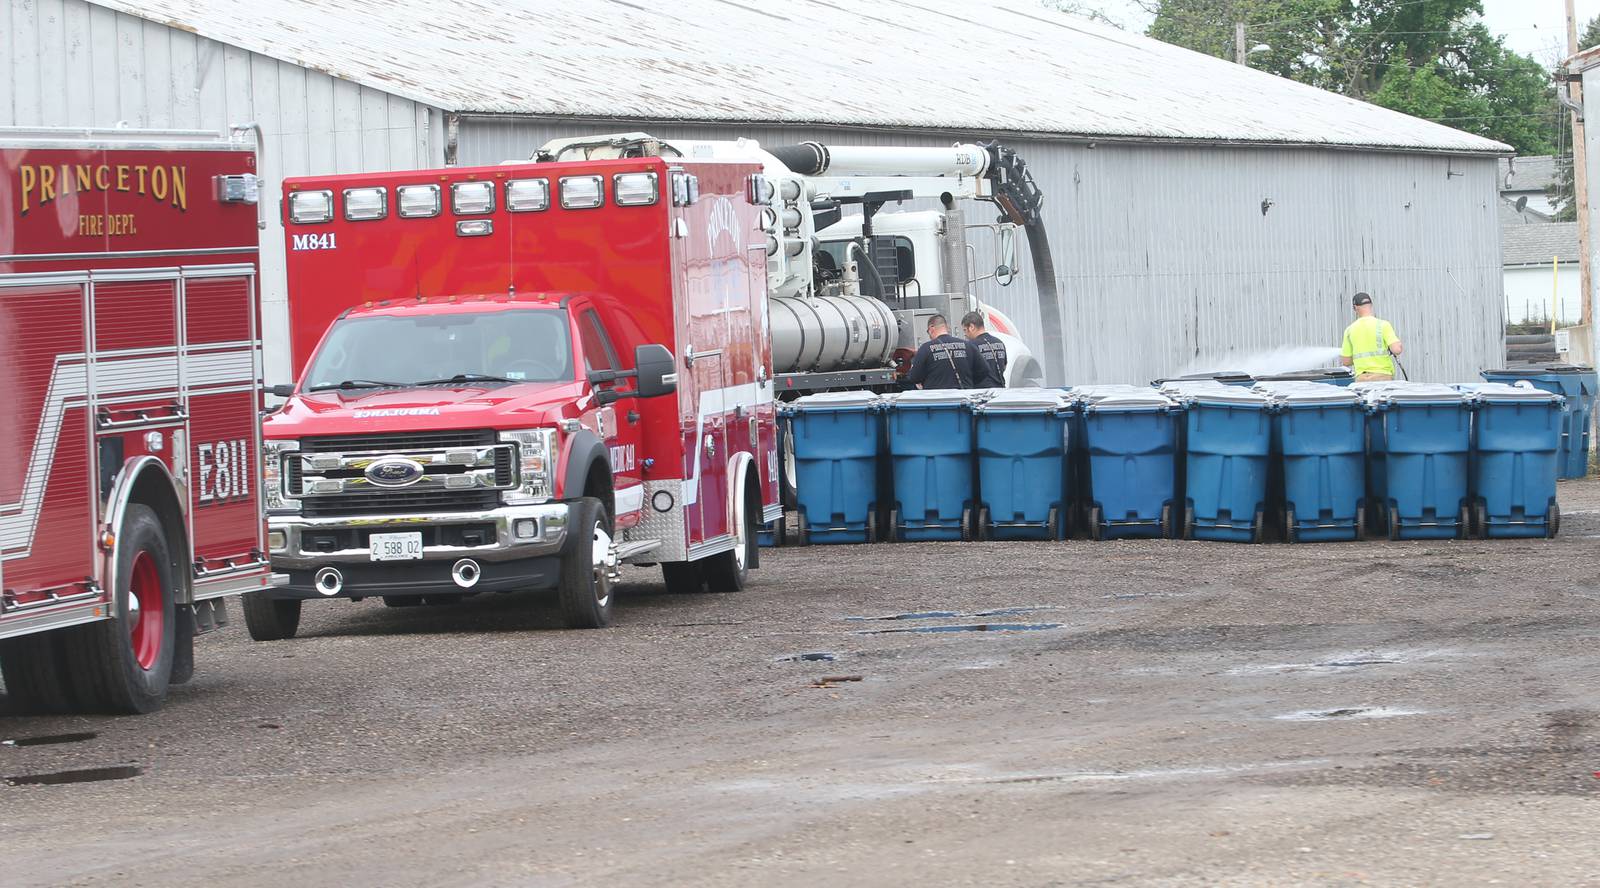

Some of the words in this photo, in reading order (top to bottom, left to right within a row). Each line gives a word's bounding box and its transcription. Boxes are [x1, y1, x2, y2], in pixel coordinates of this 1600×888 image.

[20, 164, 188, 216] PRINCETON
[79, 215, 104, 236] FIRE
[108, 213, 137, 235] DEPT.
[292, 233, 337, 251] M841
[198, 439, 249, 502] E811
[380, 465, 408, 478] Ford
